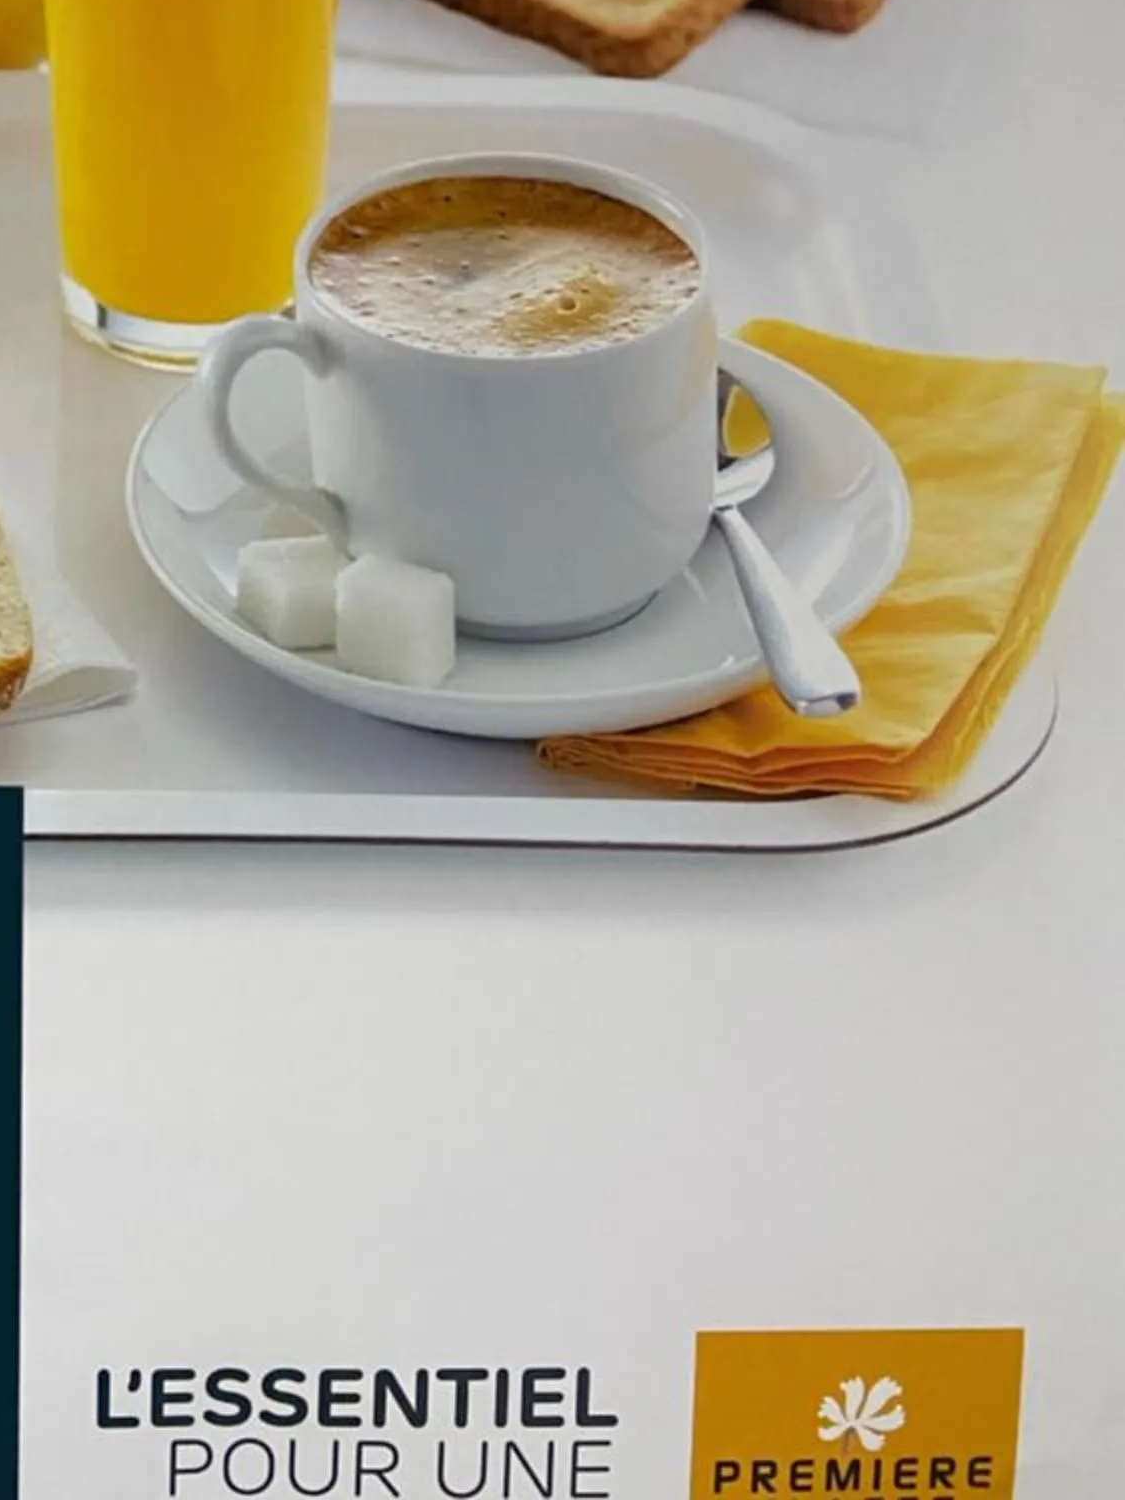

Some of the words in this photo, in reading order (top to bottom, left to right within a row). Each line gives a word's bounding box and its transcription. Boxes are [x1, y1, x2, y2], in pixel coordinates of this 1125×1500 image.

[169, 1437, 400, 1498] POUR
[437, 1440, 612, 1499] UNE
[714, 1456, 992, 1494] PREMIERE
